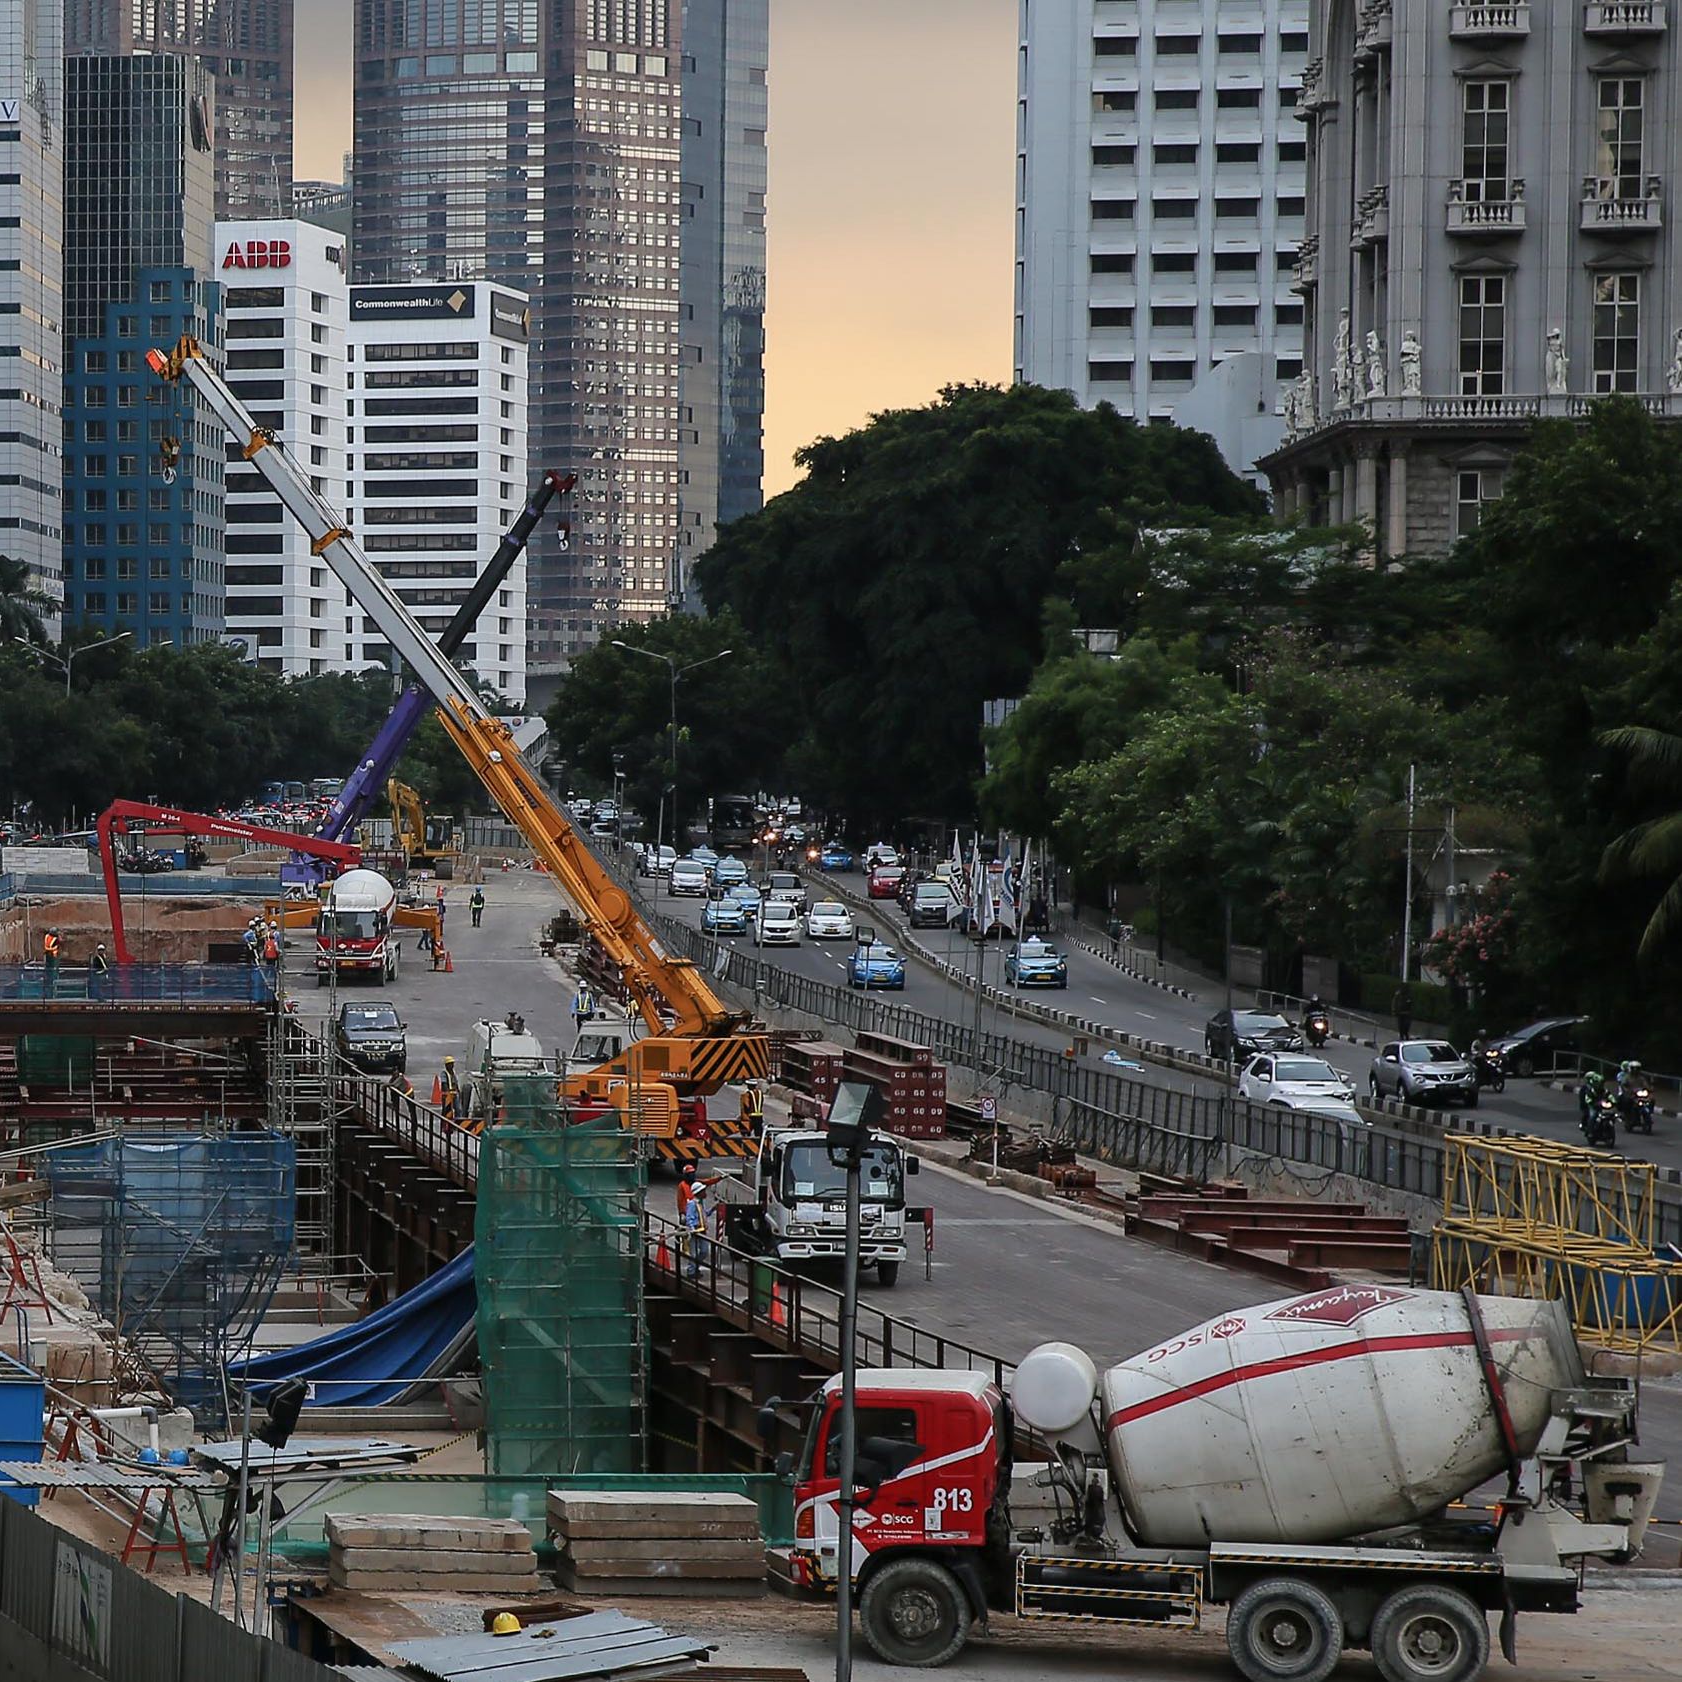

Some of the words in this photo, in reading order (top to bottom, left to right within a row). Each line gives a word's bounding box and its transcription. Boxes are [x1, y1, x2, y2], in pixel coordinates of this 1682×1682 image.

[222, 240, 291, 269] ABB
[1147, 1333, 1202, 1364] SCG
[933, 1487, 973, 1512] 813
[895, 1515, 915, 1524] SCG
